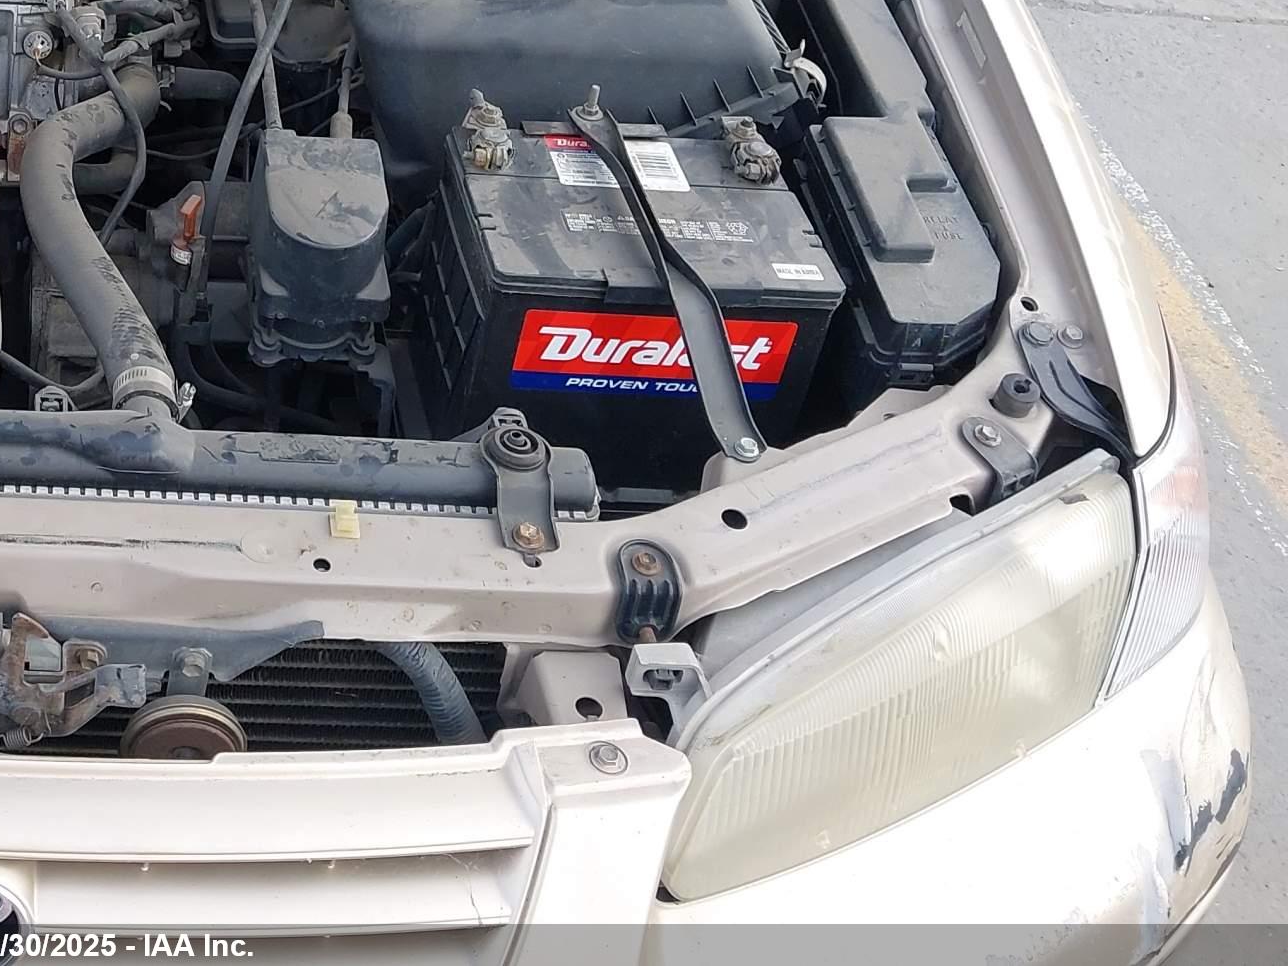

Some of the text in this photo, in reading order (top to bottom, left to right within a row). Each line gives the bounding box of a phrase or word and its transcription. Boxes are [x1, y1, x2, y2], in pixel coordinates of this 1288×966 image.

[554, 138, 590, 147] Dura
[538, 326, 773, 371] Duralst
[565, 377, 699, 394] PROVEN TOU
